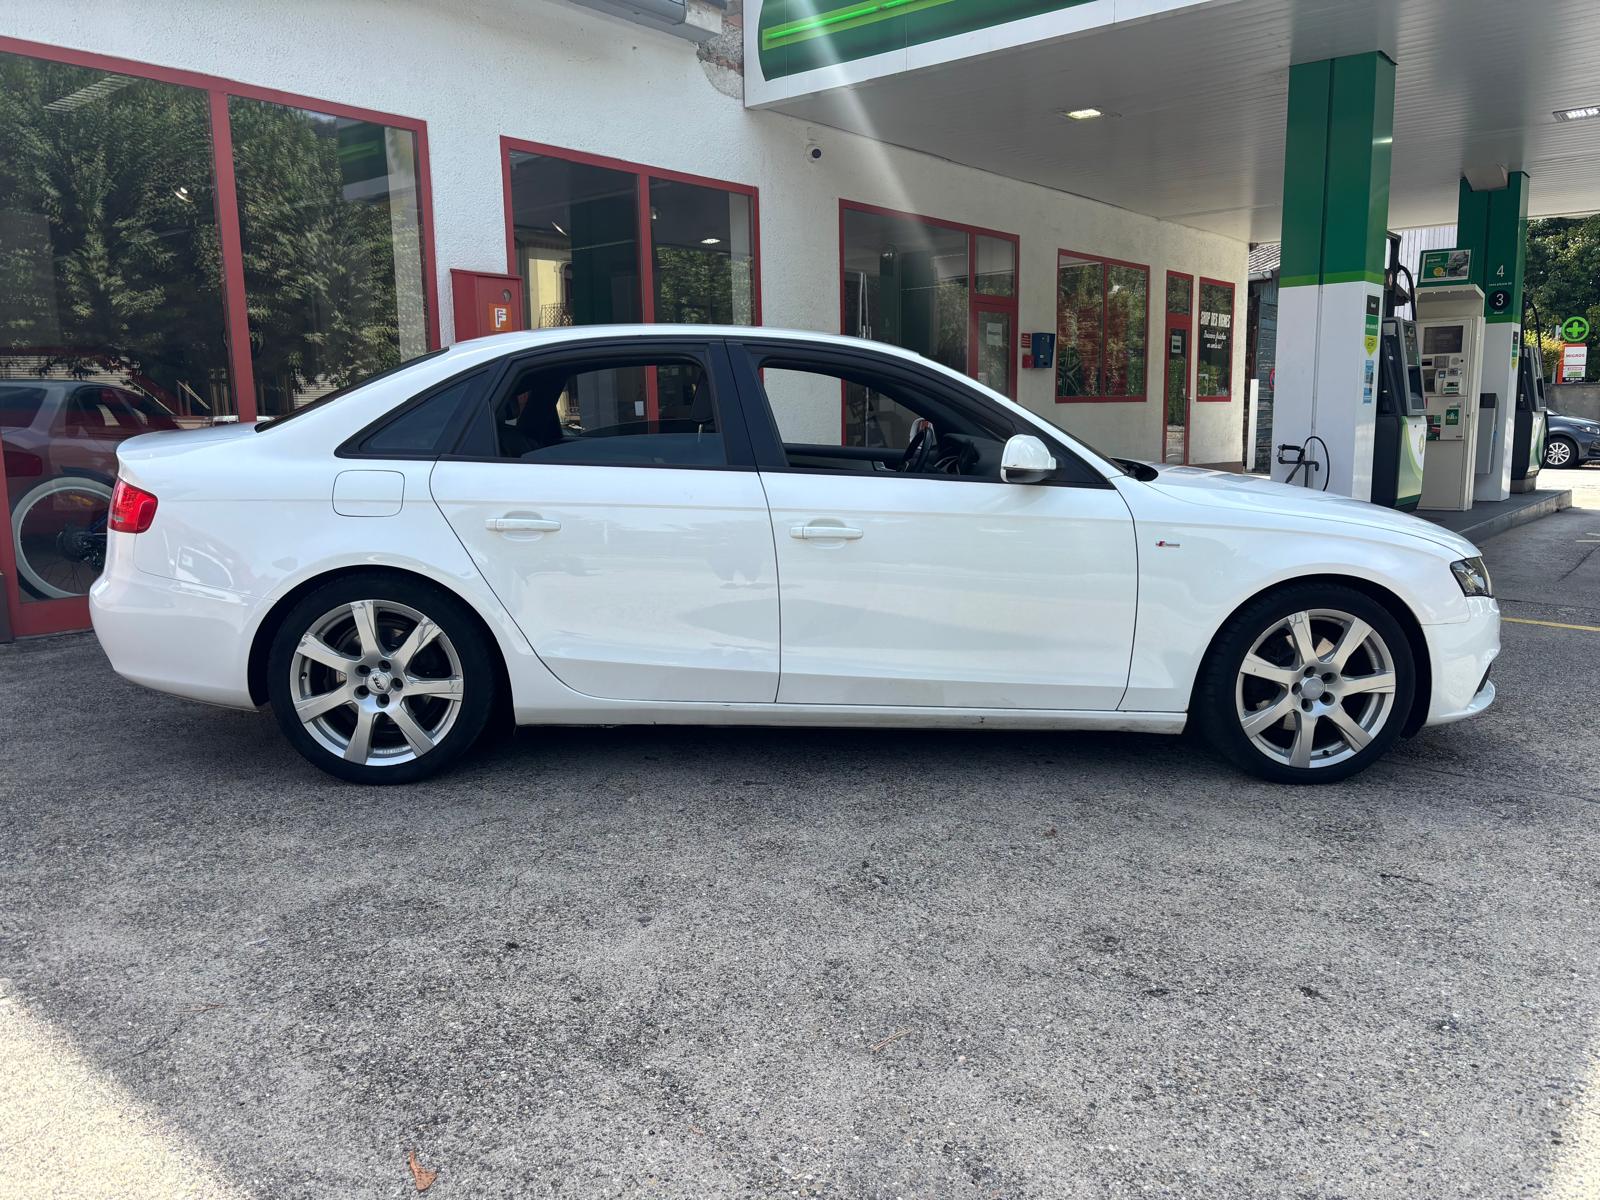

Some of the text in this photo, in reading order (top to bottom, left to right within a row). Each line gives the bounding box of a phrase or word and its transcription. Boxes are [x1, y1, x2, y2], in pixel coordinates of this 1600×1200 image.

[1496, 264, 1505, 278] 4
[1495, 293, 1504, 306] 3
[494, 307, 507, 328] F
[1200, 311, 1210, 325] SHOP
